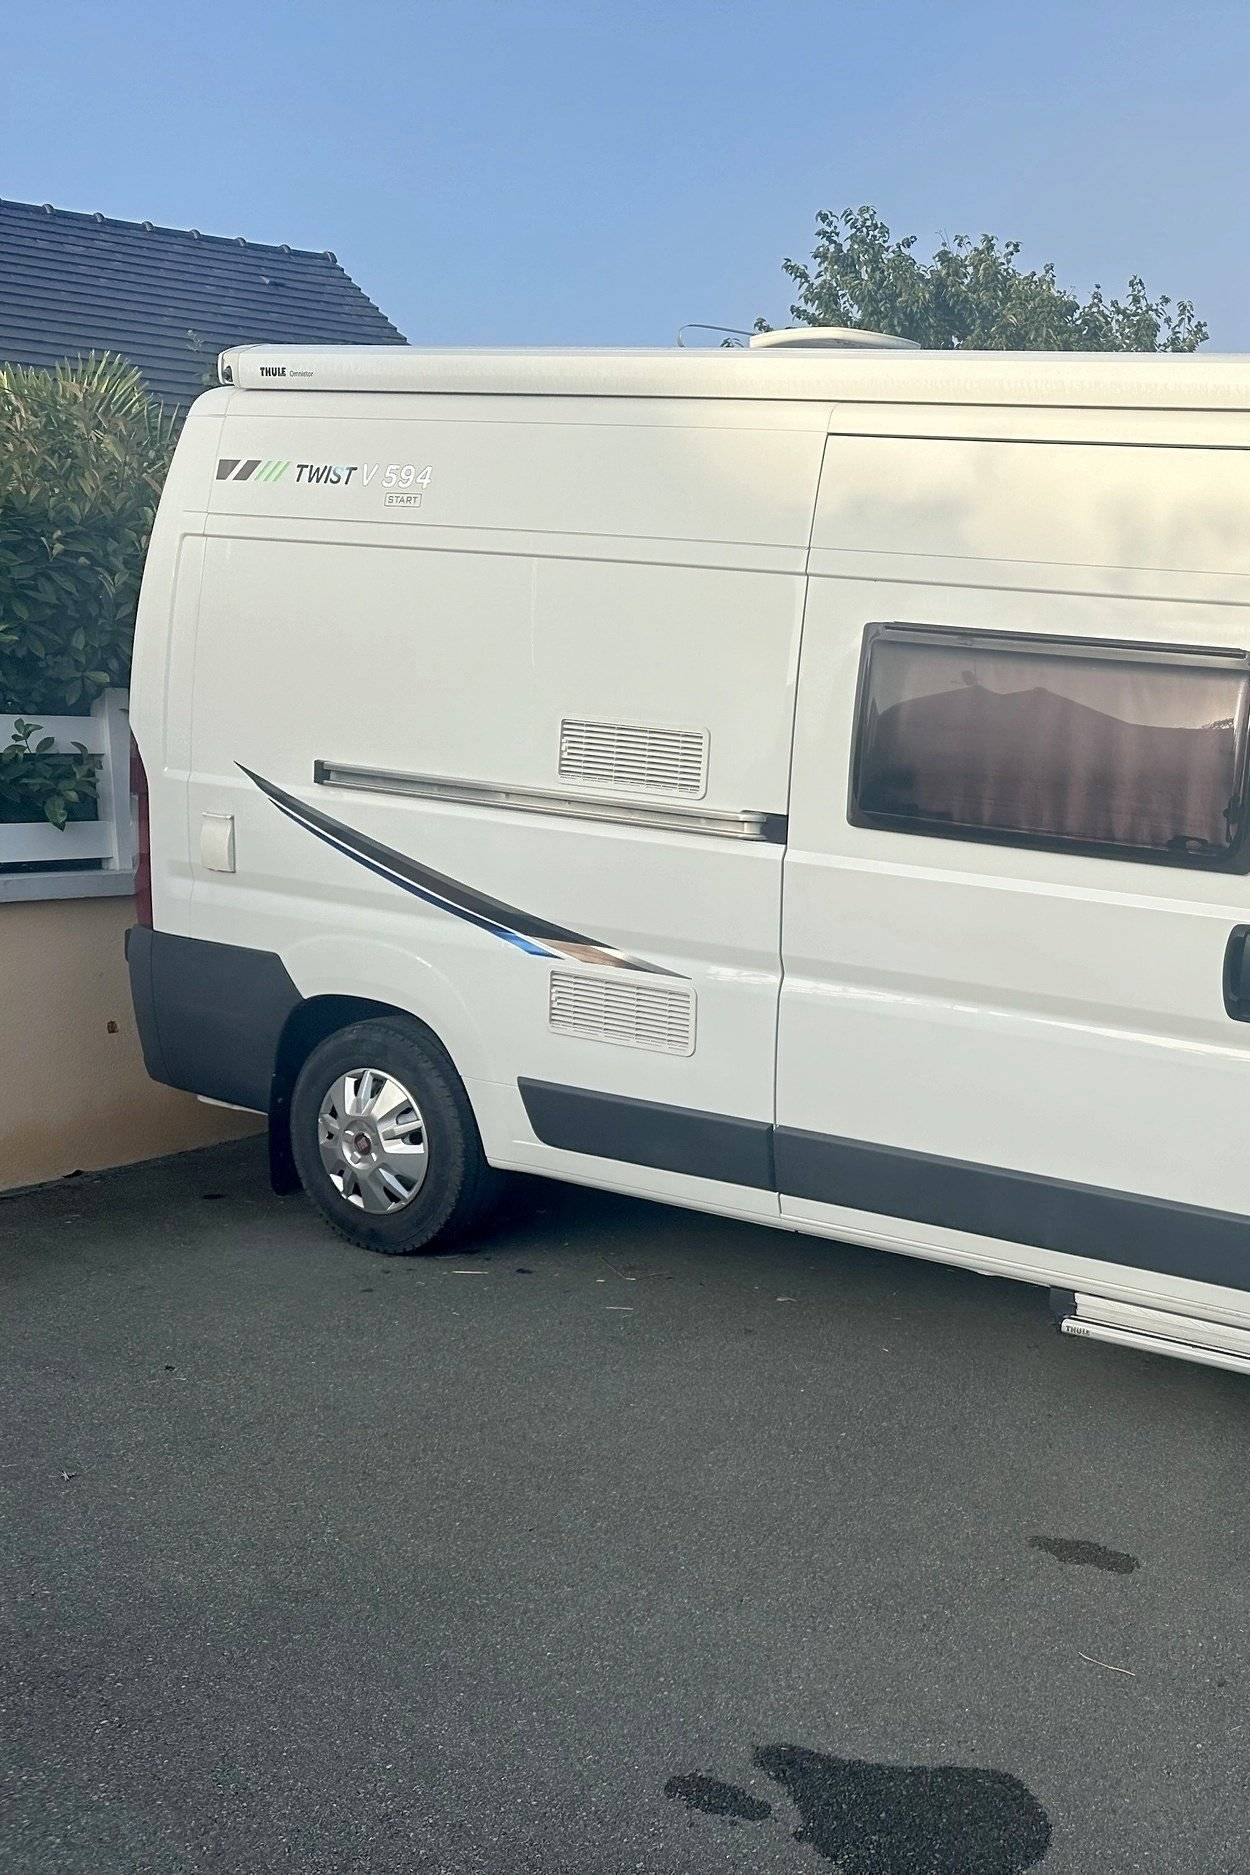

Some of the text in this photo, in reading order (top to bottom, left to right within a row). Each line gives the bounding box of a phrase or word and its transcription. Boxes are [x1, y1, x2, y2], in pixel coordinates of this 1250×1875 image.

[259, 366, 287, 377] THULE
[295, 462, 433, 490] TWIST V 594
[387, 494, 419, 505] START
